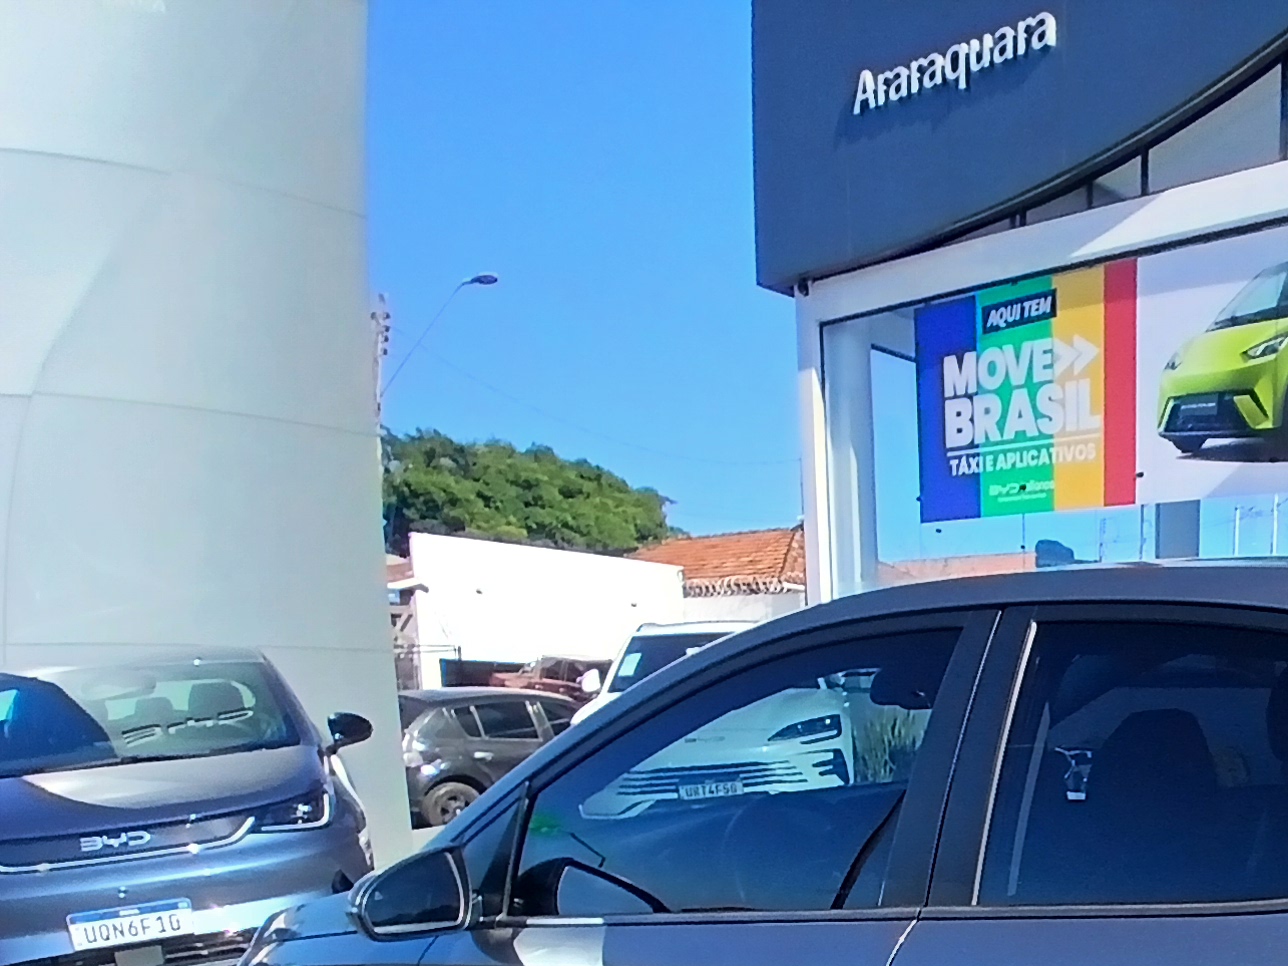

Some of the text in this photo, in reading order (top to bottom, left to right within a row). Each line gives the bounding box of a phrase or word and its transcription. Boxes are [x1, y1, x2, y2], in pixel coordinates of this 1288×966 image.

[853, 11, 1056, 115] Araraquara
[986, 296, 1052, 328] AQUI TEM
[943, 338, 1055, 398] MOVE
[944, 378, 1101, 449] BRASIL
[985, 454, 994, 473] E
[995, 442, 1096, 472] APLICATIVOS
[80, 831, 151, 852] BYD
